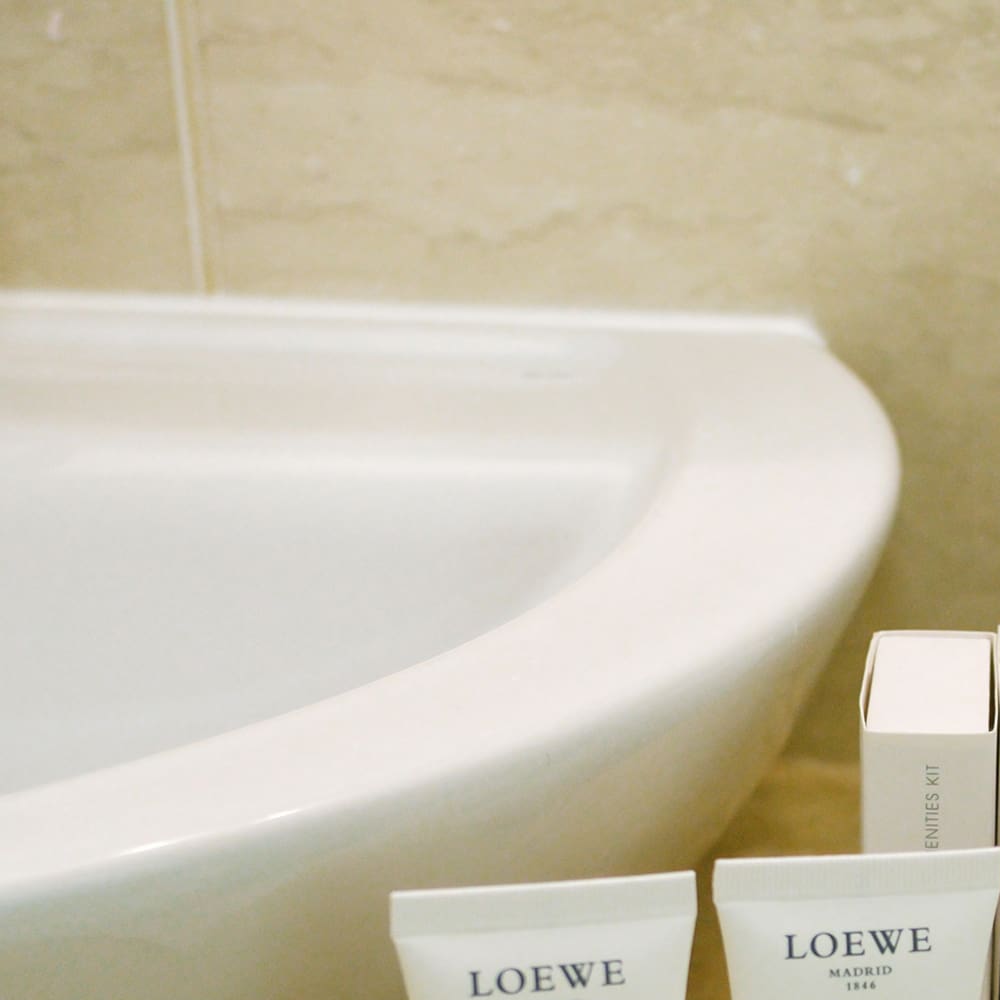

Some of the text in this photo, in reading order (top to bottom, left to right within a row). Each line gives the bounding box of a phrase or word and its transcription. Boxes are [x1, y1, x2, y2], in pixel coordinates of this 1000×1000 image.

[924, 764, 940, 849] ENITIES KIT
[785, 927, 932, 960] LOEWE
[469, 959, 625, 998] LOEWE
[829, 965, 892, 978] MADRID
[846, 982, 876, 991] 1846
